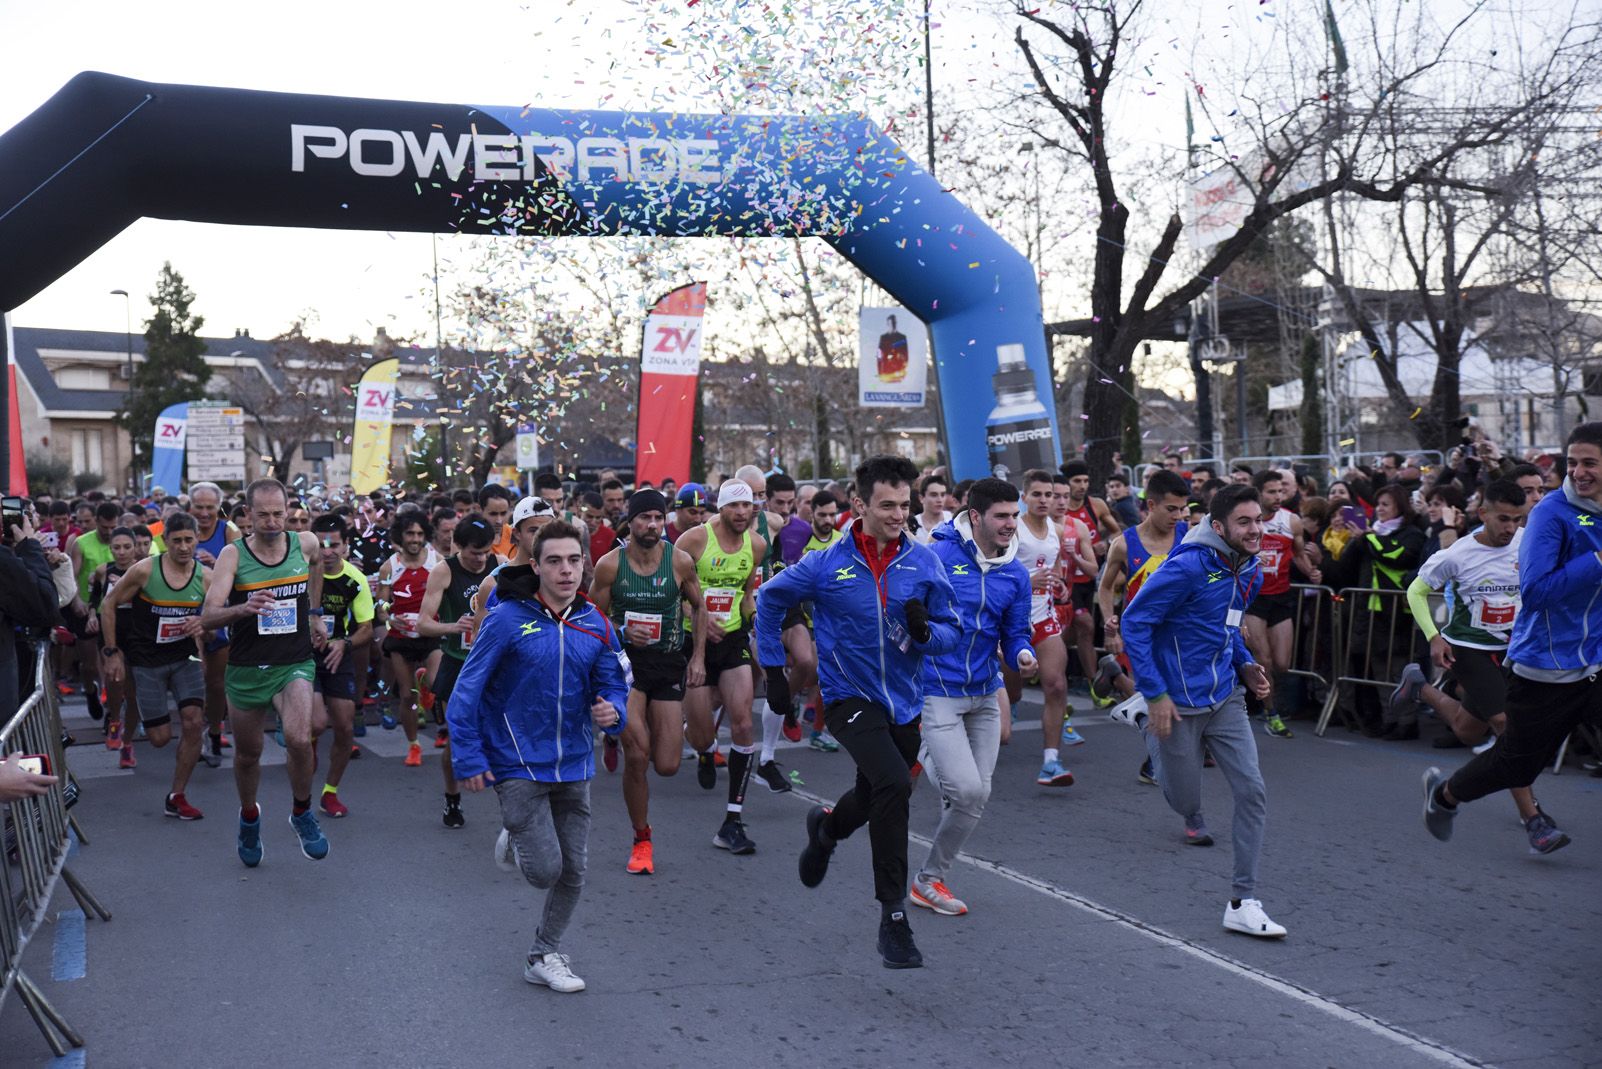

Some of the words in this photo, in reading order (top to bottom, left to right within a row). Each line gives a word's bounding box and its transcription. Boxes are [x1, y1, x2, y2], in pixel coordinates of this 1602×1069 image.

[290, 123, 722, 184] POWERADE
[652, 326, 697, 355] ZV
[648, 356, 678, 366] ZONA
[160, 423, 182, 438] ZV
